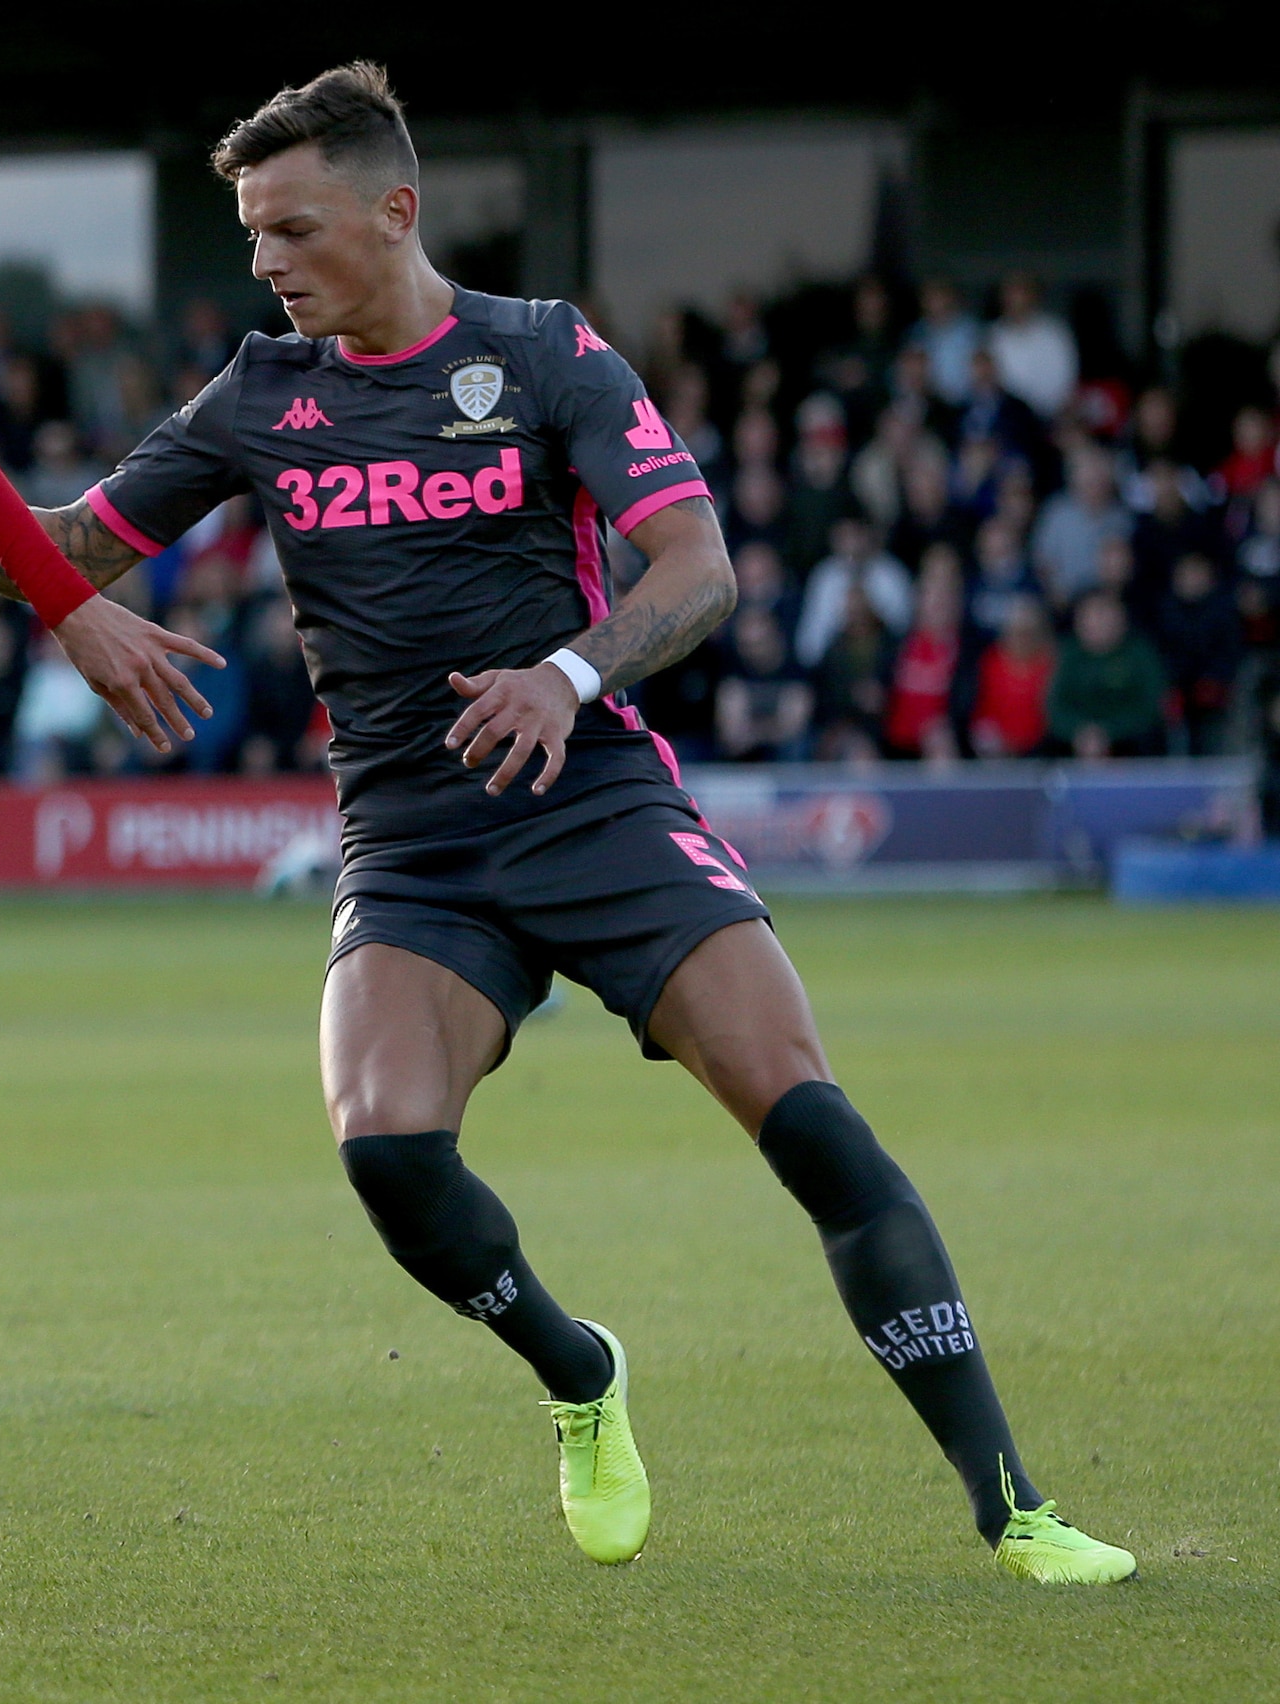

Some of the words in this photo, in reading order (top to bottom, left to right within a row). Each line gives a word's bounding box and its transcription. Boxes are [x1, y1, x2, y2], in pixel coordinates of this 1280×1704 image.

[276, 447, 524, 532] 32Red
[668, 831, 746, 891] 5
[865, 1300, 970, 1358] LEEDS
[885, 1330, 974, 1370] UNITED
